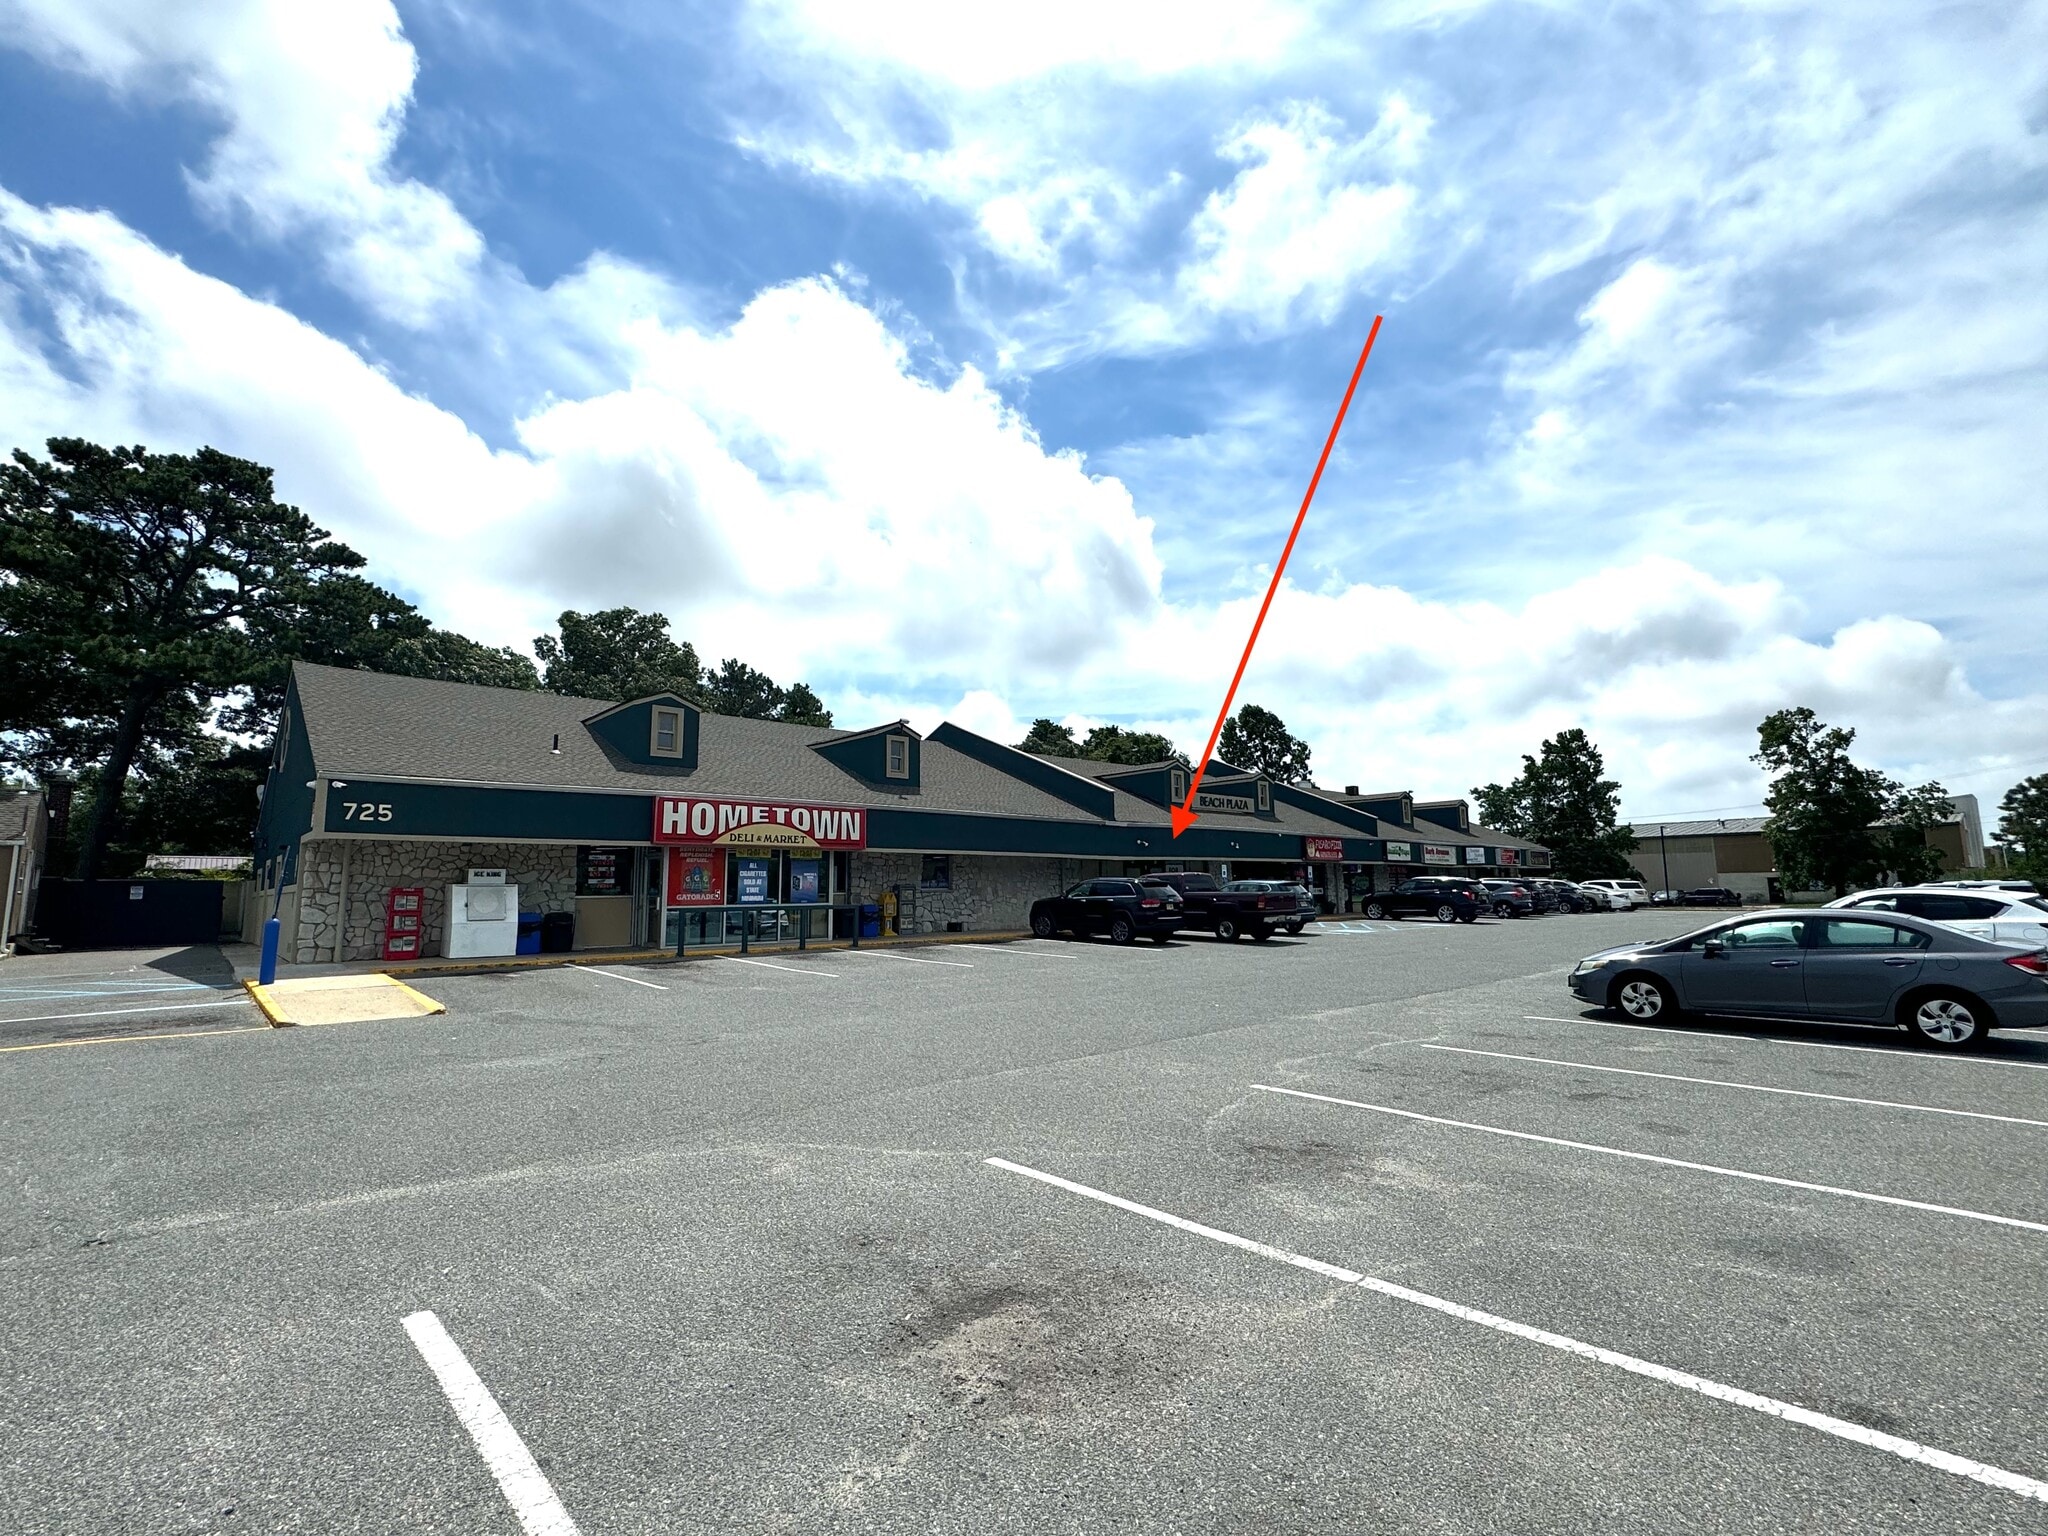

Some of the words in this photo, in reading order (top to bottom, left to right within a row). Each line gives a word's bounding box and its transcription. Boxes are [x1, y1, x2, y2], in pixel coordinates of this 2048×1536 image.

[1200, 796, 1225, 808] BEACH
[1226, 799, 1249, 810] PLAZA
[343, 802, 393, 821] 725
[662, 801, 861, 841] HOMETOWN
[729, 833, 754, 842] DELI
[763, 834, 808, 844] MARKET
[676, 893, 716, 901] GATORADE
